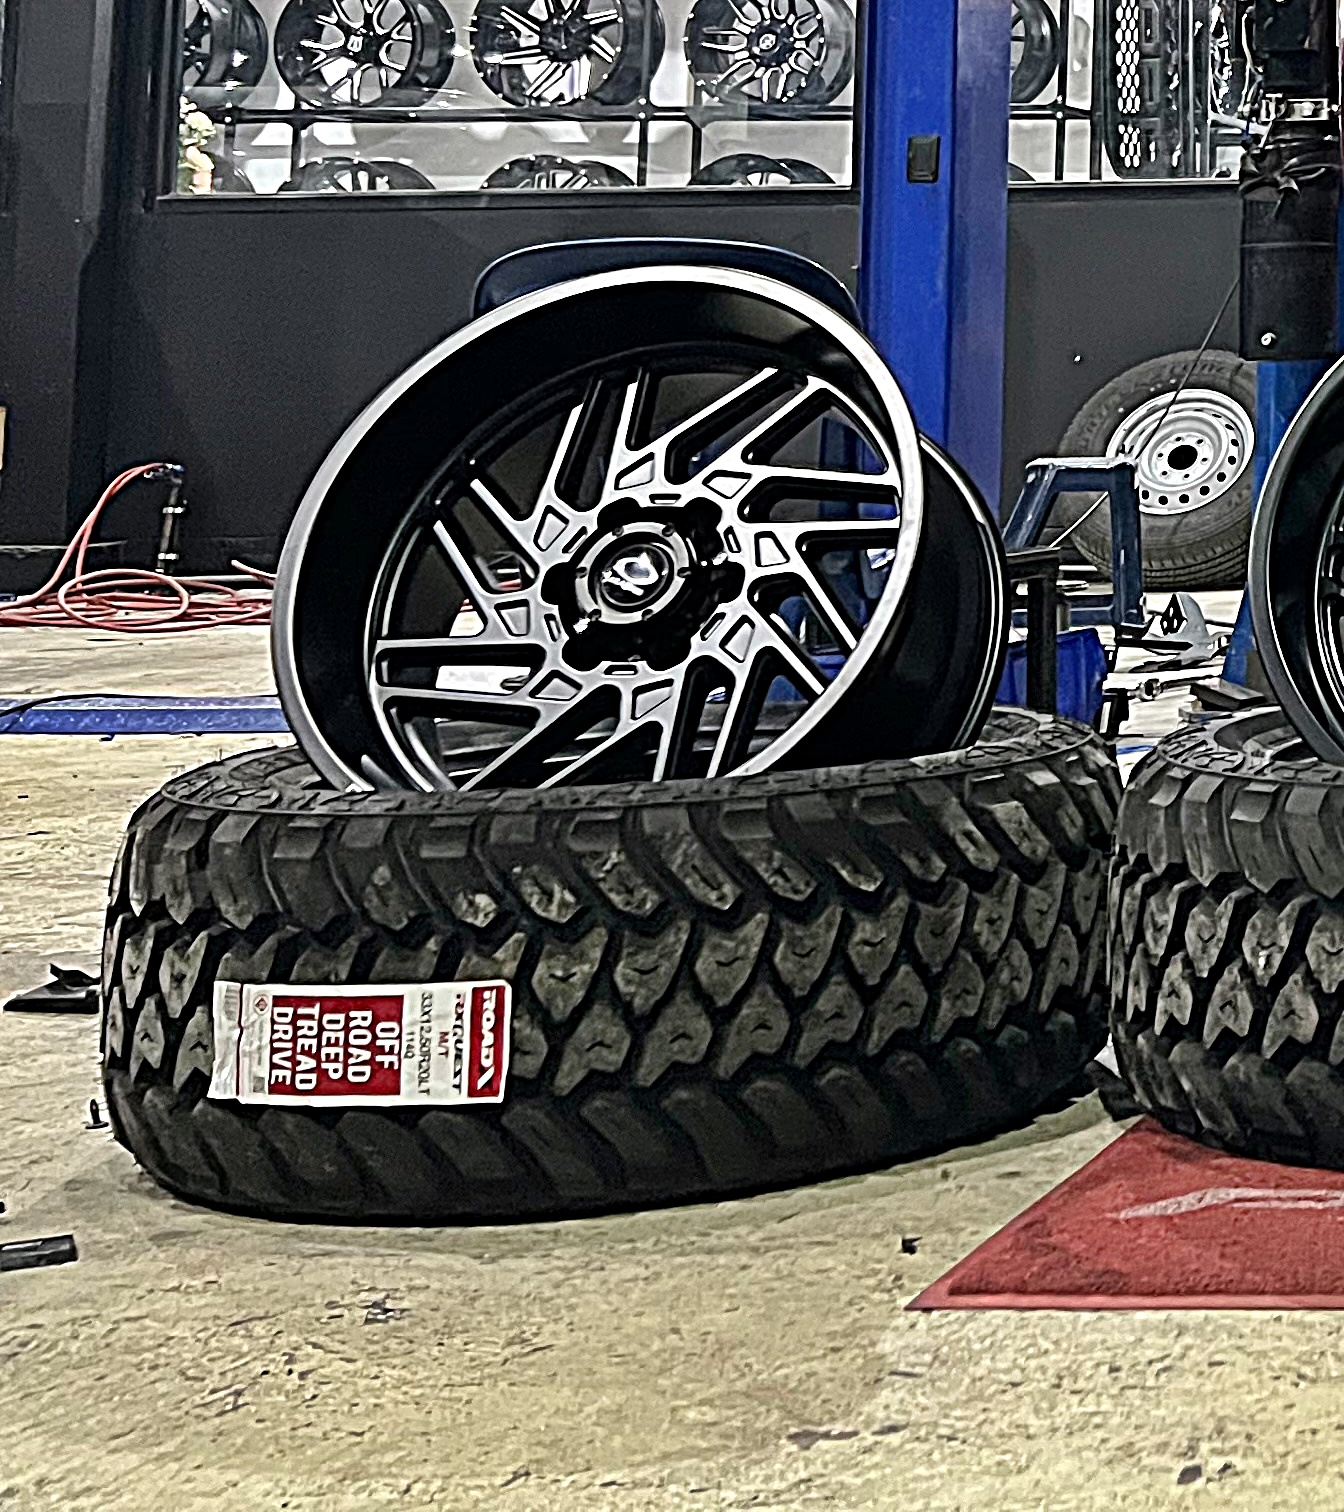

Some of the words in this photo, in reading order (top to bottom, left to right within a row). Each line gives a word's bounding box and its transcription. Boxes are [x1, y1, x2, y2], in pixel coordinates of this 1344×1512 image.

[269, 1005, 295, 1087] DRIVE
[294, 1002, 322, 1091] TREAD
[320, 1012, 346, 1081] DEEP
[346, 1009, 373, 1084] ROAD
[374, 1020, 401, 1071] OFF
